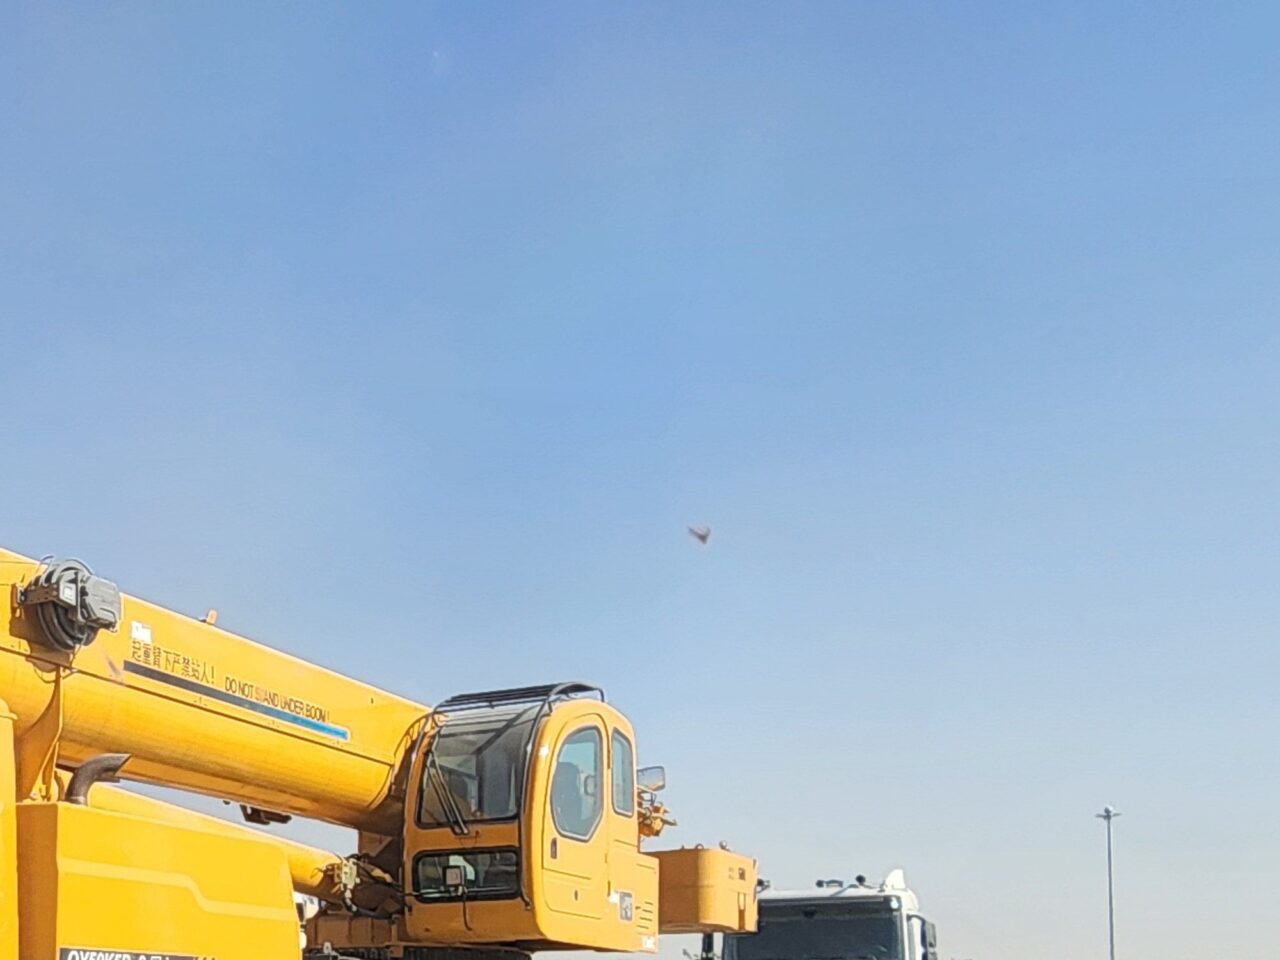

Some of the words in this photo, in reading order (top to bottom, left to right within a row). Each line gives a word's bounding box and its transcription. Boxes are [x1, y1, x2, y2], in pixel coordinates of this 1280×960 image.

[224, 676, 238, 694] DO
[238, 680, 254, 698] NOT
[279, 694, 304, 715] UNDER
